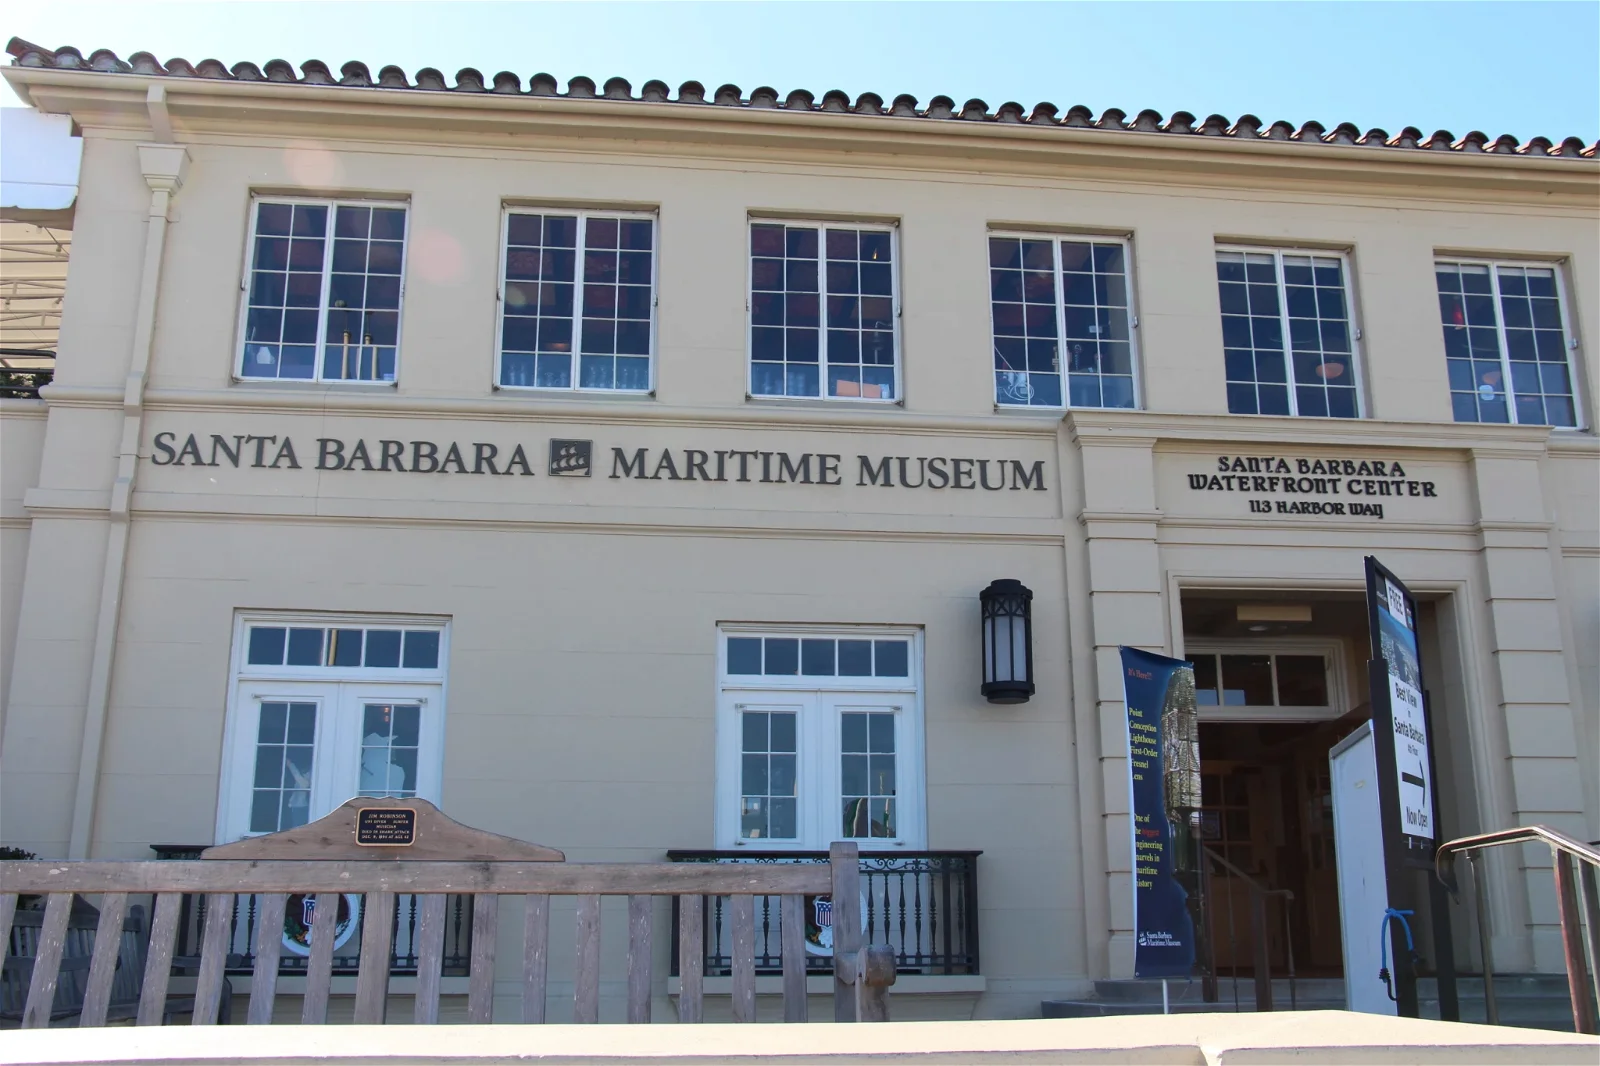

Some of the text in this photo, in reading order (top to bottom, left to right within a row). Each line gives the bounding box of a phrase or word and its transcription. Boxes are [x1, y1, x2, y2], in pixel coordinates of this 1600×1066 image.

[151, 432, 1048, 492] SANTA BARBARA MARITIME MUSEUM
[1217, 456, 1406, 478] SANTA BARBARA
[1187, 473, 1438, 498] WATERFRONT CENTER
[1248, 500, 1384, 519] 113 HARBOR WAY
[1388, 585, 1404, 616] FREE
[1395, 682, 1418, 709] Best View
[1128, 707, 1143, 718] Point
[1129, 719, 1157, 734] Conception
[1394, 716, 1425, 746] Santa Barbara
[1130, 734, 1157, 745] Lighthouse
[1130, 745, 1158, 758] First-Order
[1132, 773, 1143, 781] ens
[1406, 805, 1428, 832] Now Open
[1136, 840, 1163, 852] ngineering
[1154, 854, 1160, 862] in
[1137, 879, 1152, 890] istory
[1157, 931, 1172, 940] Barbara
[1165, 938, 1182, 947] Museum
